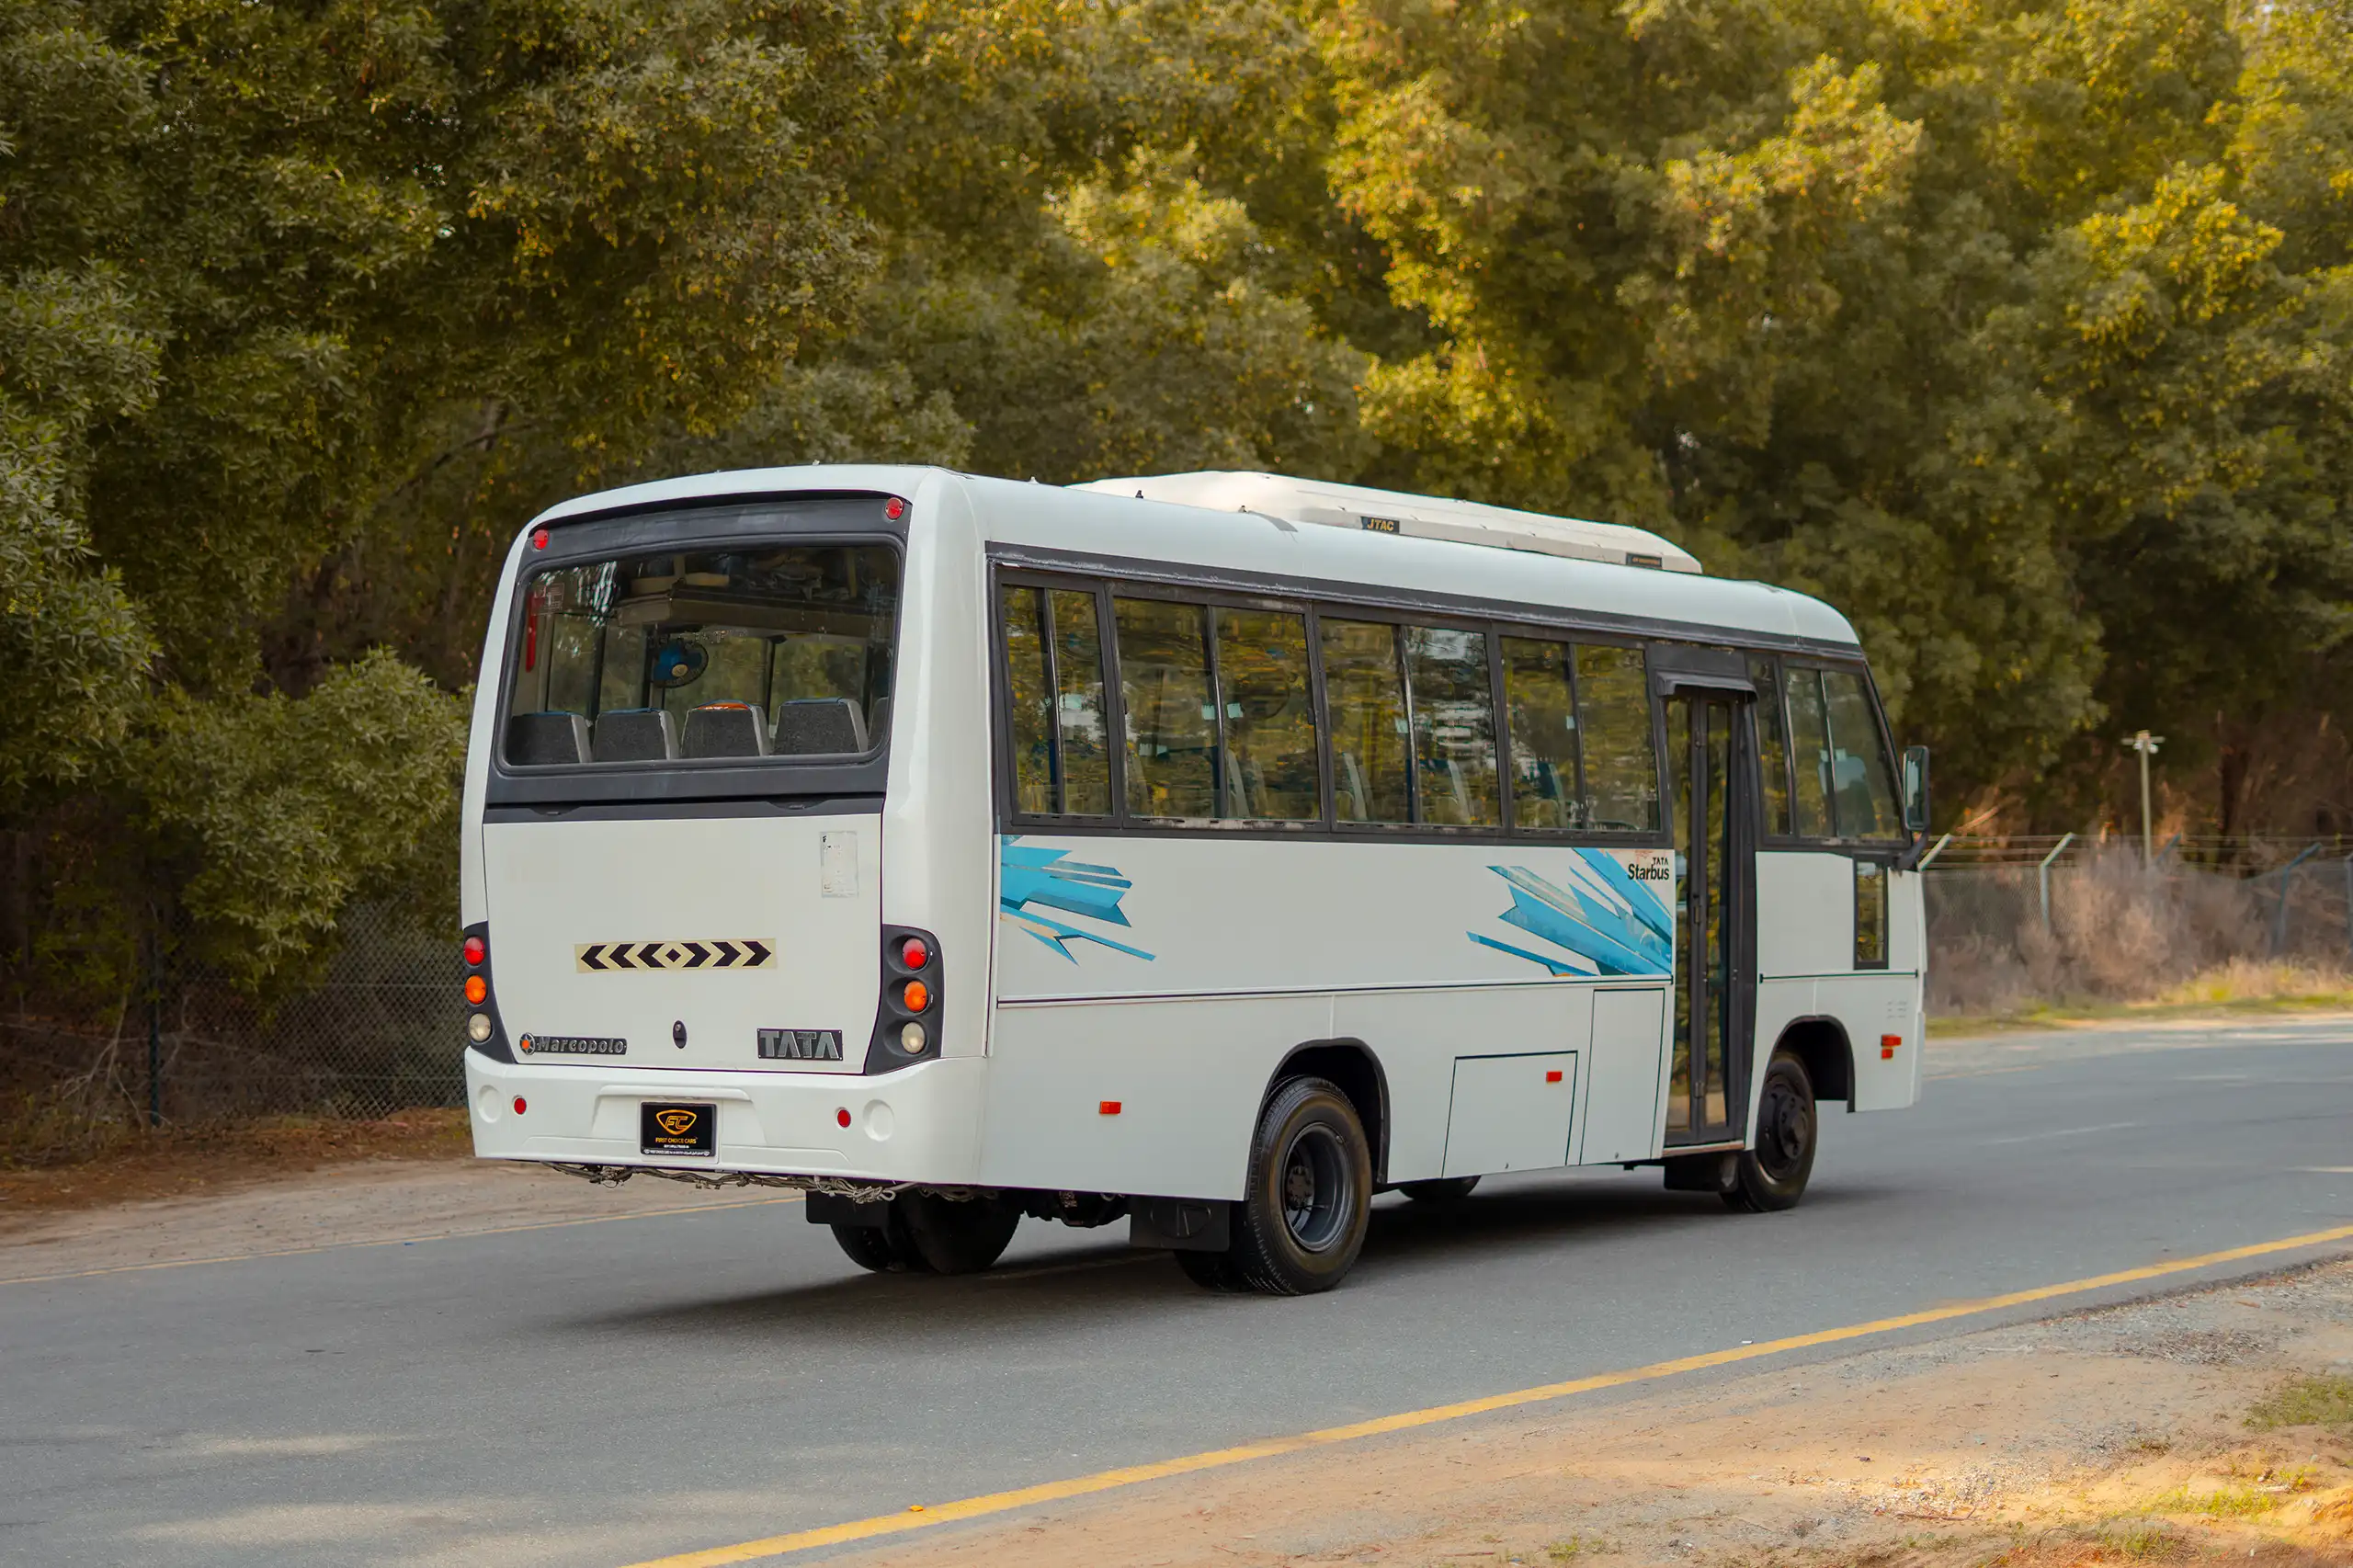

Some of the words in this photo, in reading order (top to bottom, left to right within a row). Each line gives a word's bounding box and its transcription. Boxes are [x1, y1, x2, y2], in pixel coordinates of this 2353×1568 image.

[1367, 518, 1394, 531] JTAC
[1652, 857, 1669, 865] TATA
[1628, 863, 1670, 880] Starbus
[537, 1037, 624, 1053] Marcopolo
[759, 1030, 839, 1059] TATA
